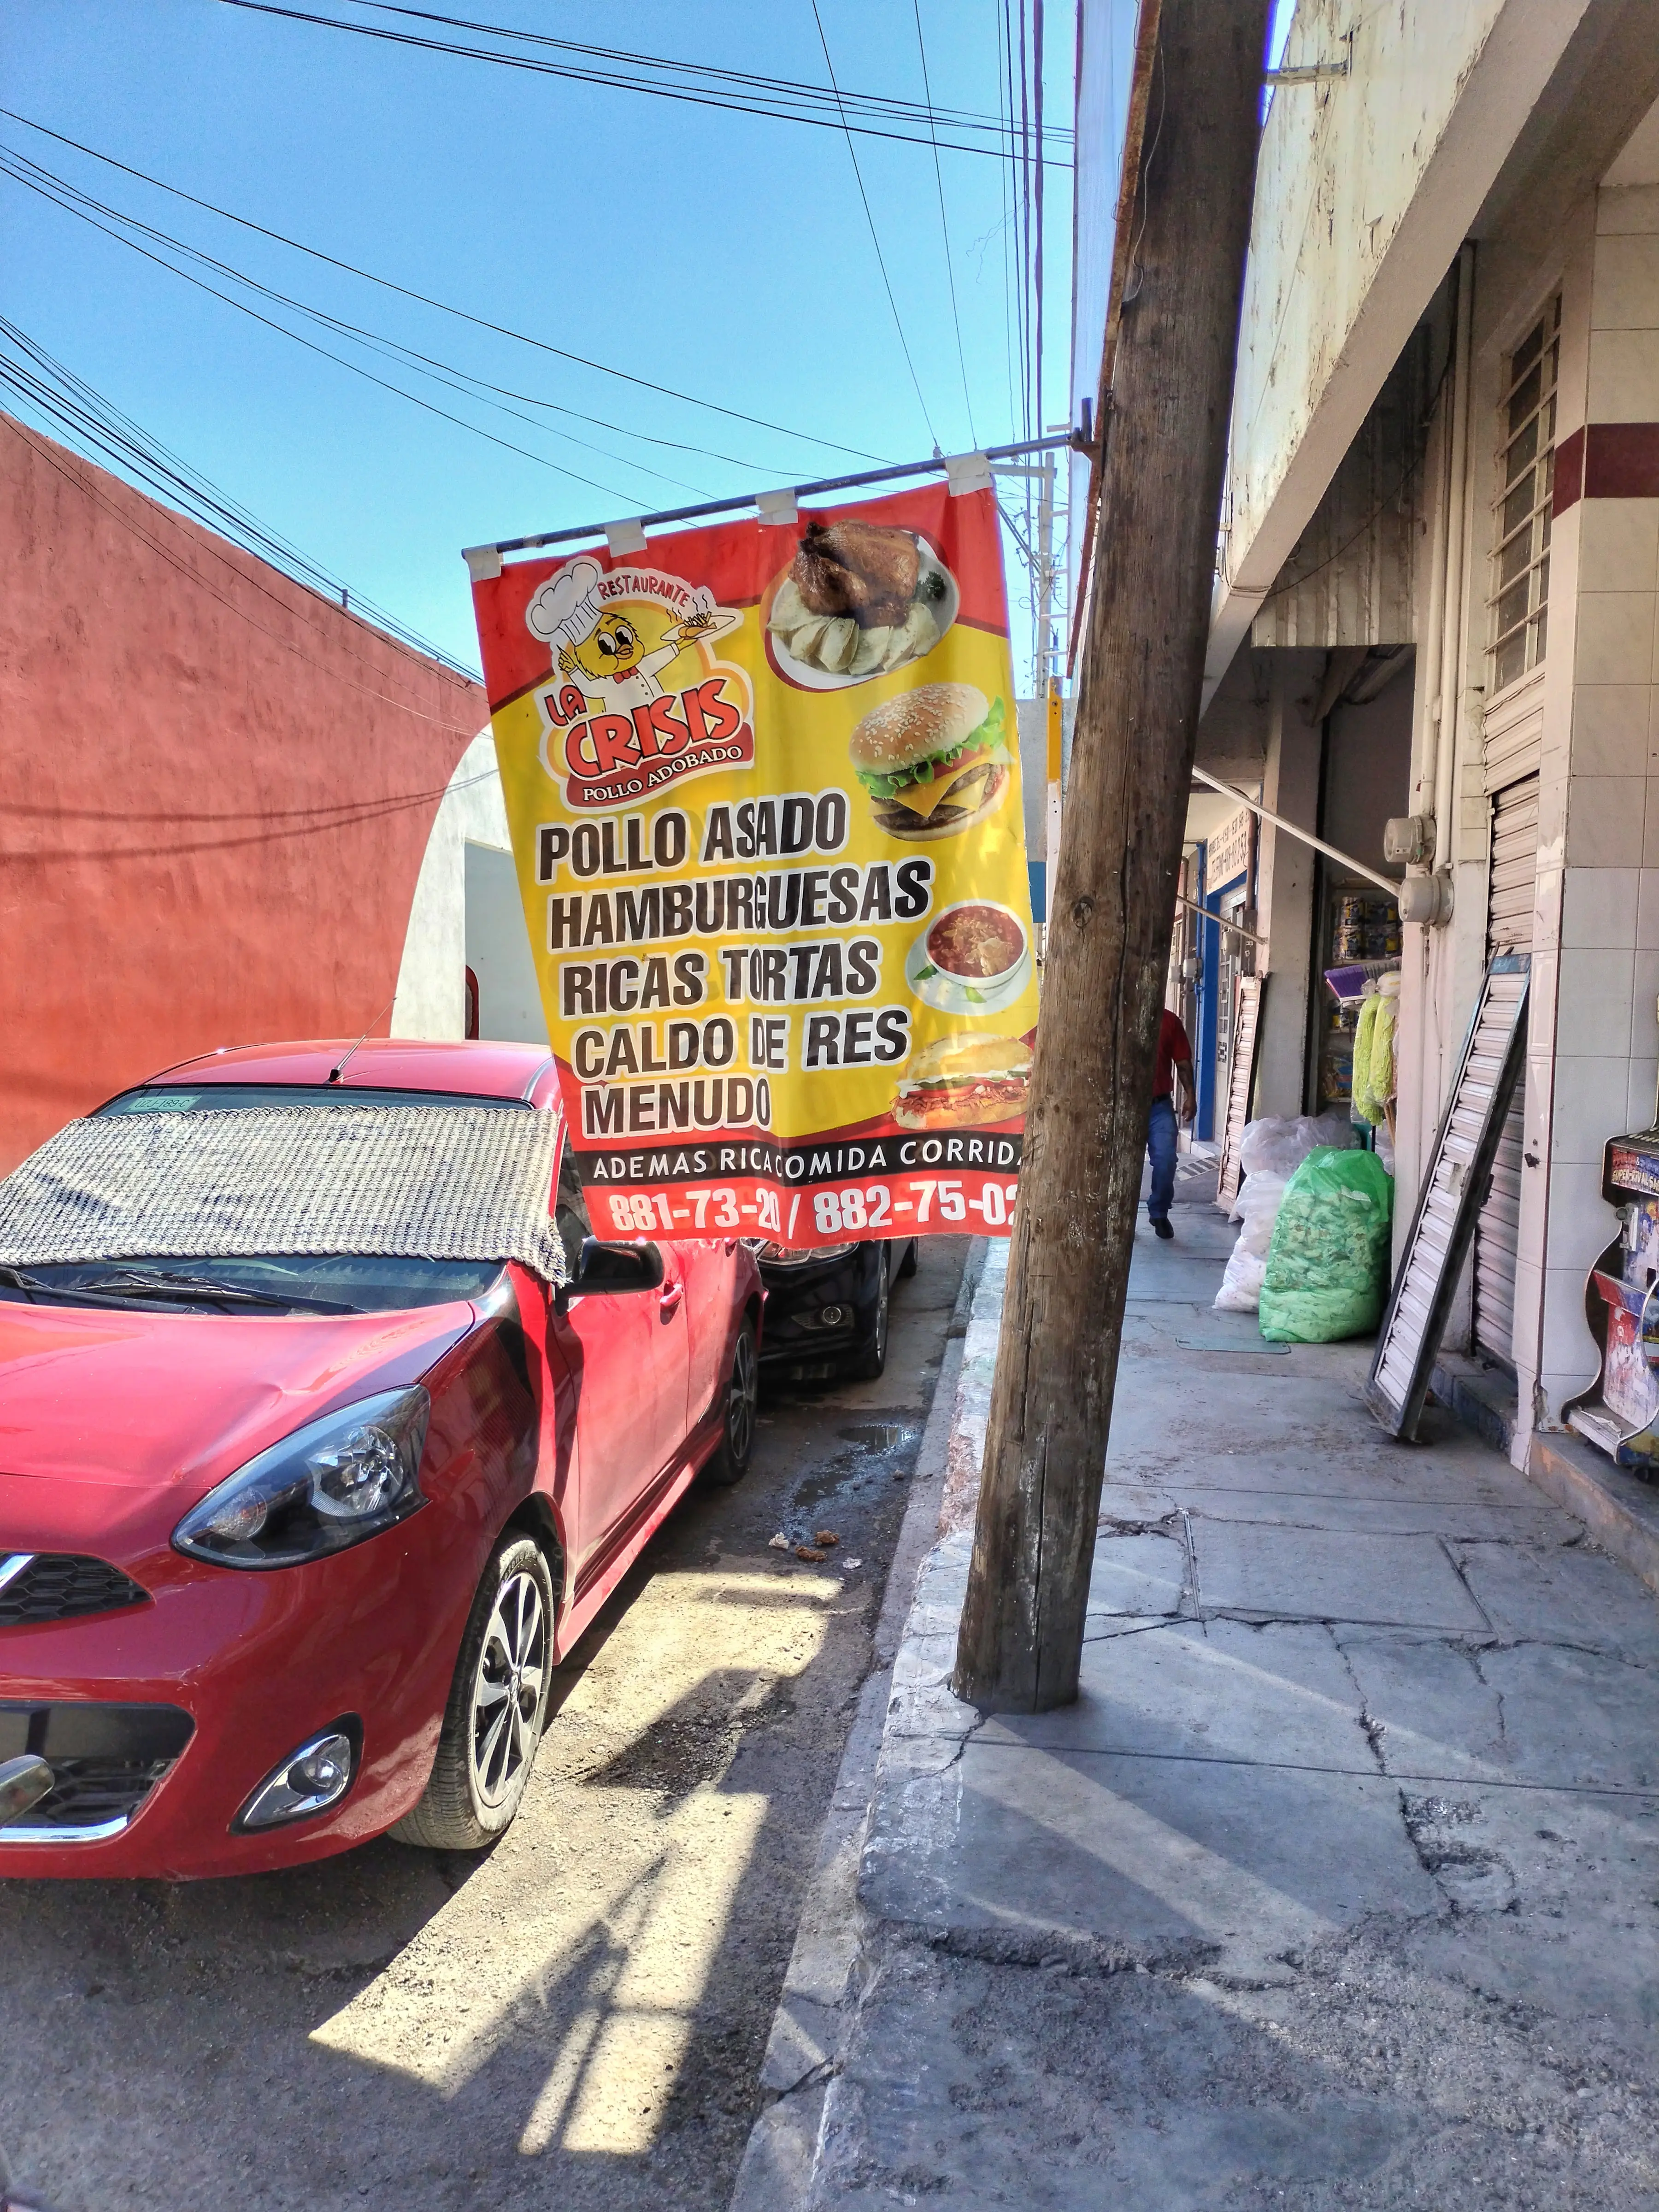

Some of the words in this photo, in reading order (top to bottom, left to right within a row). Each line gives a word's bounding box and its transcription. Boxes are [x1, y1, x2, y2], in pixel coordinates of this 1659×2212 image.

[597, 575, 690, 607] RESTAURANTE
[543, 684, 587, 726] LA
[565, 679, 741, 778] CRISIS
[583, 780, 642, 801] POLLO
[647, 746, 742, 787] ADOBADO
[540, 812, 686, 881] POLLO
[703, 793, 847, 862] ASADO
[552, 860, 931, 949] HAMBURGUESAS
[564, 953, 704, 1017] RICAS
[723, 941, 878, 1001] TORTAS
[575, 1018, 735, 1078] CALDO
[752, 1018, 785, 1070] DE
[806, 1010, 907, 1068] RES
[135, 1100, 189, 1108] UZJ-189-C
[585, 1078, 771, 1135] MENUDO
[593, 1150, 707, 1179] ADEMAS
[776, 1145, 887, 1178] COMIDA
[901, 1139, 1022, 1165] CORRID
[611, 1188, 781, 1233] 881-73-20
